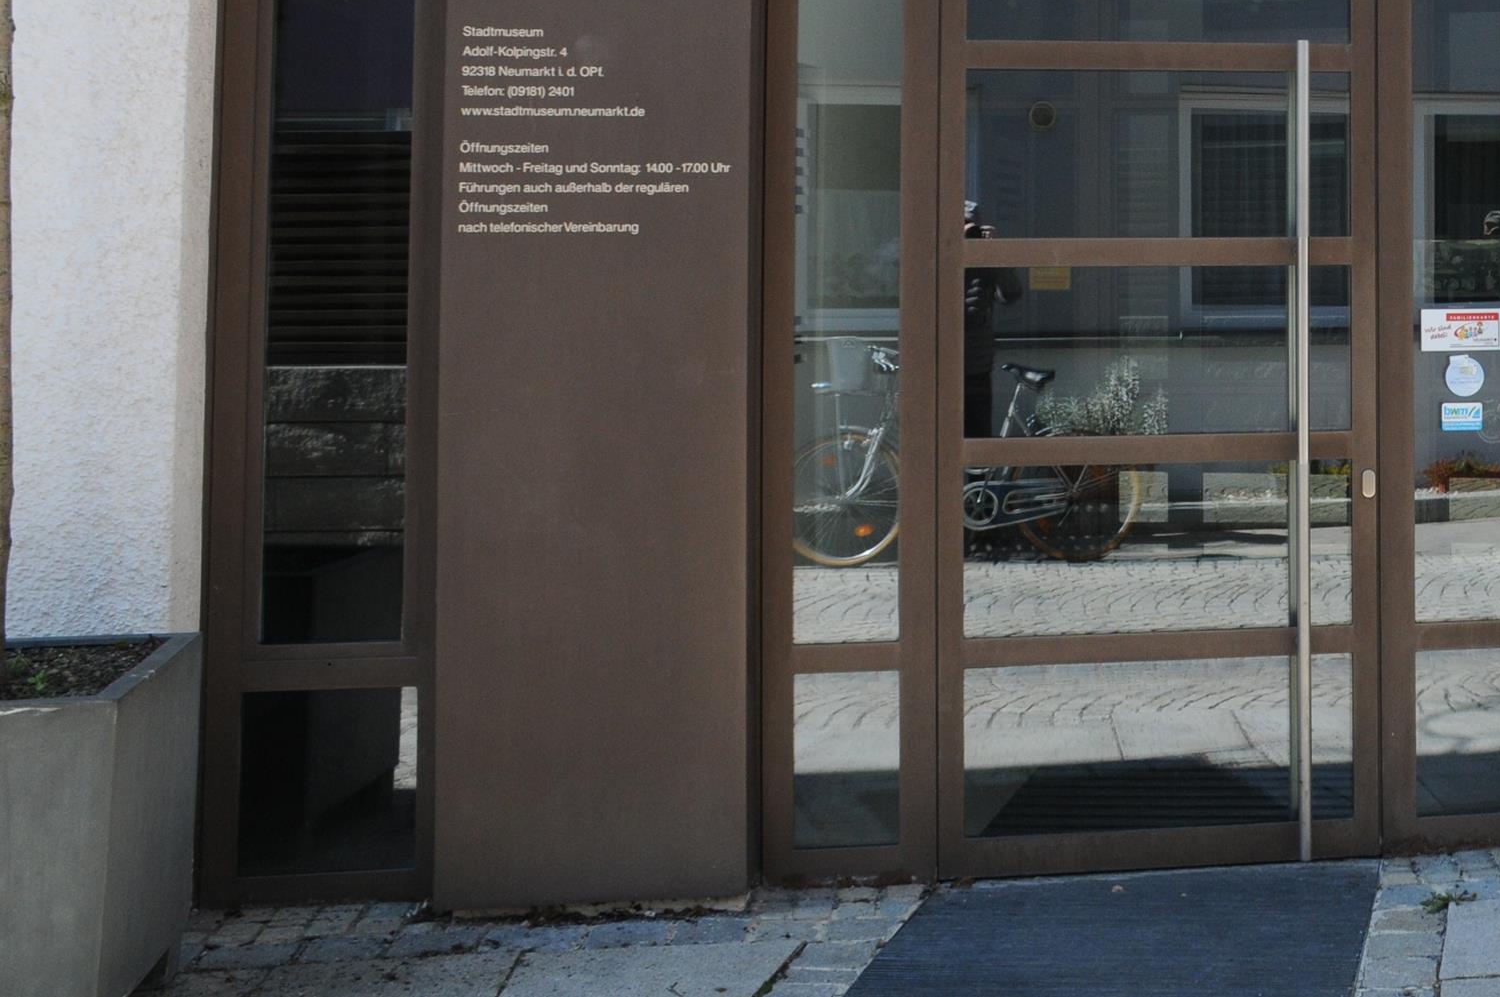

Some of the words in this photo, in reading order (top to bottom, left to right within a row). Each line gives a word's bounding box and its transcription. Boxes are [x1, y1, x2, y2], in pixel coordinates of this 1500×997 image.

[463, 26, 543, 37] Stadtmuseum
[463, 46, 557, 59] Adolf-Kolpingstr.
[560, 48, 567, 56] 4
[462, 66, 496, 76] 92318
[499, 66, 555, 76] Neumarkt
[567, 67, 577, 76] d.
[580, 66, 604, 77] OPf.
[462, 85, 504, 96] Telefon:
[507, 86, 545, 98] (09181)
[548, 86, 574, 96] 2401
[461, 106, 645, 116] www.stadtmuseum.neumarkt.de
[460, 140, 548, 155] Öffnungszeiten
[460, 162, 513, 173] Mittwoch
[523, 162, 563, 175] Freitag
[565, 163, 587, 173] und
[590, 162, 640, 175] Sonntag:
[646, 163, 673, 173] 14.00
[711, 163, 730, 173] Uhr
[459, 182, 520, 195] Führungen
[523, 183, 552, 192] auch
[555, 182, 612, 193] außerhalb
[615, 183, 634, 192] der
[636, 182, 689, 195] regulären
[459, 200, 548, 215] Öffnungszeiten
[458, 222, 487, 232] nach
[490, 222, 562, 232] telefonischer
[564, 222, 639, 234] Vereinbarung
